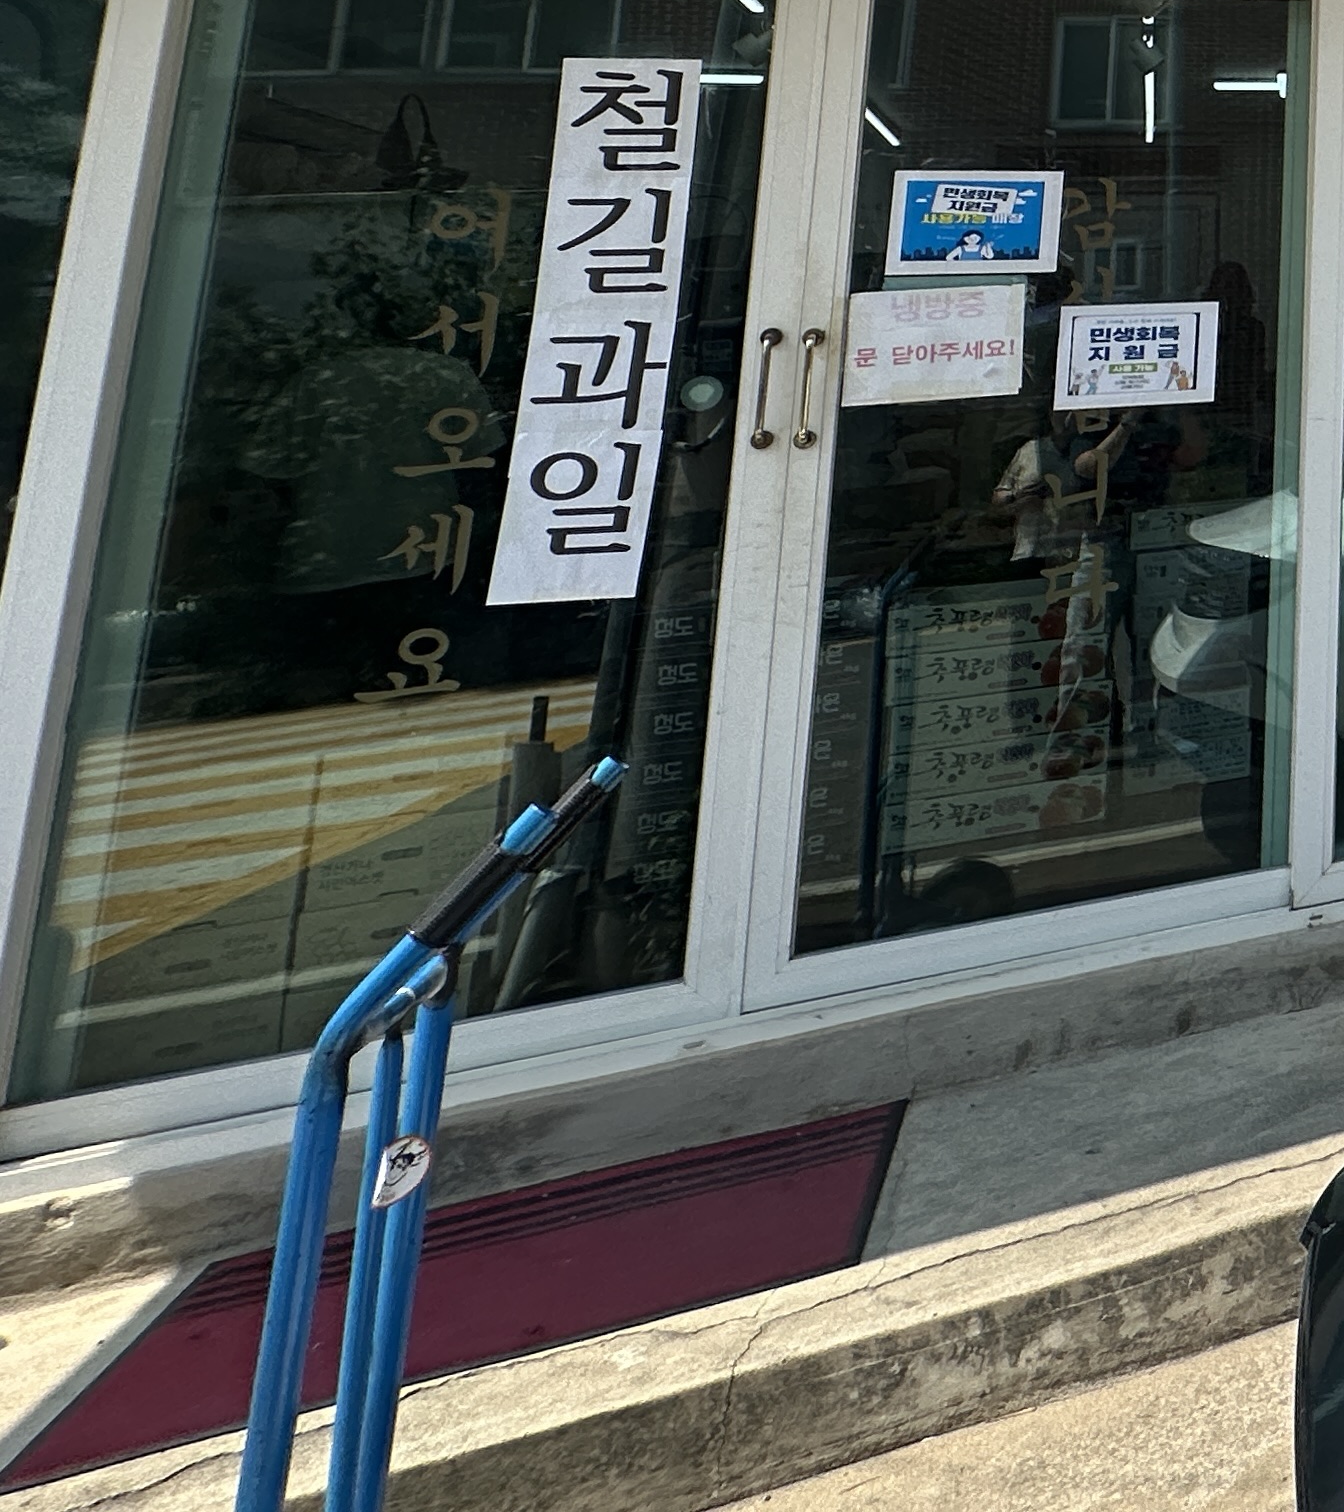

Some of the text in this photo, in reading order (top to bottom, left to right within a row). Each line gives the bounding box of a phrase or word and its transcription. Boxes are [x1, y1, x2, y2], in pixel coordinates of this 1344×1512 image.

[943, 187, 1010, 202] 민생회복
[947, 200, 998, 213] 지원금
[528, 70, 682, 556] 철길과일
[891, 291, 988, 322] 냉방중
[1090, 326, 1180, 343] 민생회복
[853, 339, 1016, 368] 문 닫아주세요!
[353, 188, 512, 705] 어서오세요
